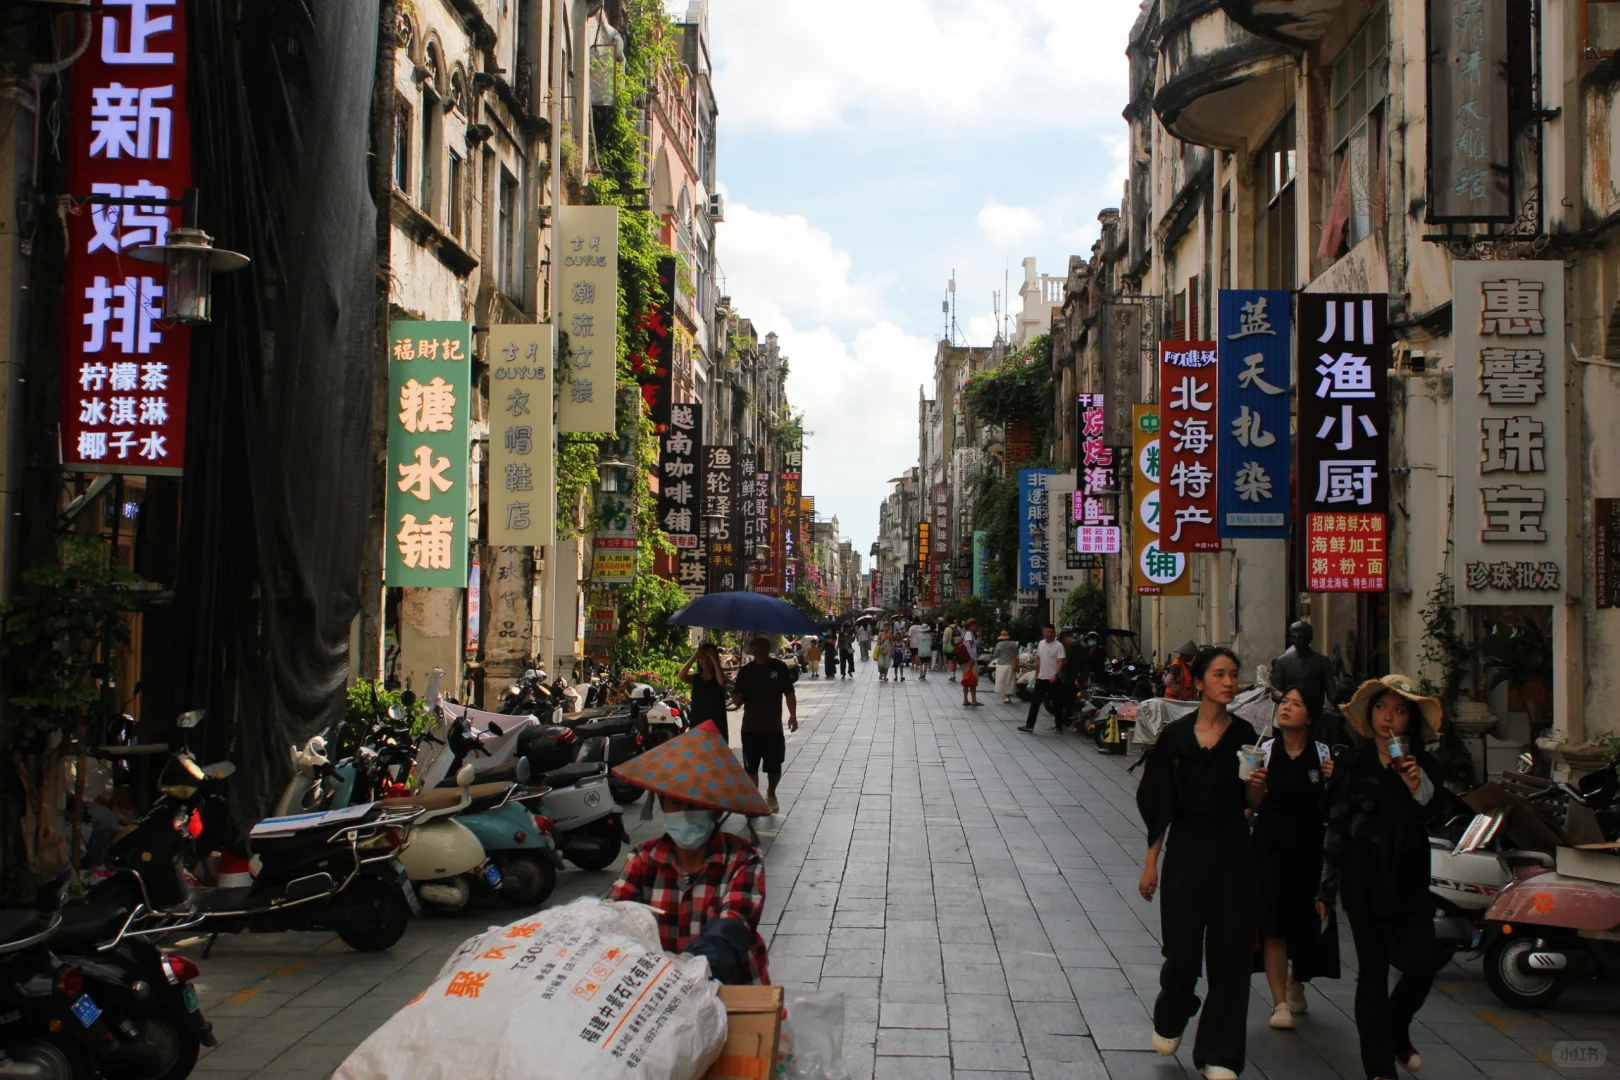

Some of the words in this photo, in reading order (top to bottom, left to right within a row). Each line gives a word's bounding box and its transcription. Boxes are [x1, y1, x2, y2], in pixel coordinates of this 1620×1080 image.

[83, 0, 176, 354] 正新鸡排
[570, 236, 599, 251] 古月
[564, 255, 606, 267] GUYUE
[394, 338, 464, 361] 福財記
[501, 344, 538, 362] 古月
[571, 279, 596, 403] 潮流女装
[79, 362, 169, 391] 柠檬茶
[494, 365, 545, 380] GUYUE
[78, 396, 168, 426] 冰淇淋
[1228, 296, 1286, 502] 蓝天扎染
[1315, 300, 1378, 505] 川渔小厨
[1479, 279, 1546, 544] 惠馨珠宝
[77, 431, 167, 459] 椰子水
[504, 387, 533, 531] 衣帽鞋店
[1169, 376, 1213, 542] 北海特产
[397, 377, 456, 570] 糖水铺
[664, 405, 695, 532] 越南咖啡铺
[1312, 515, 1382, 532] 招牌海鲜大咖
[1312, 537, 1382, 553] 海鲜加工
[1312, 577, 1349, 588] 地道北海味
[1353, 577, 1383, 588] 特色川菜
[1467, 560, 1560, 592] 珍珠批发
